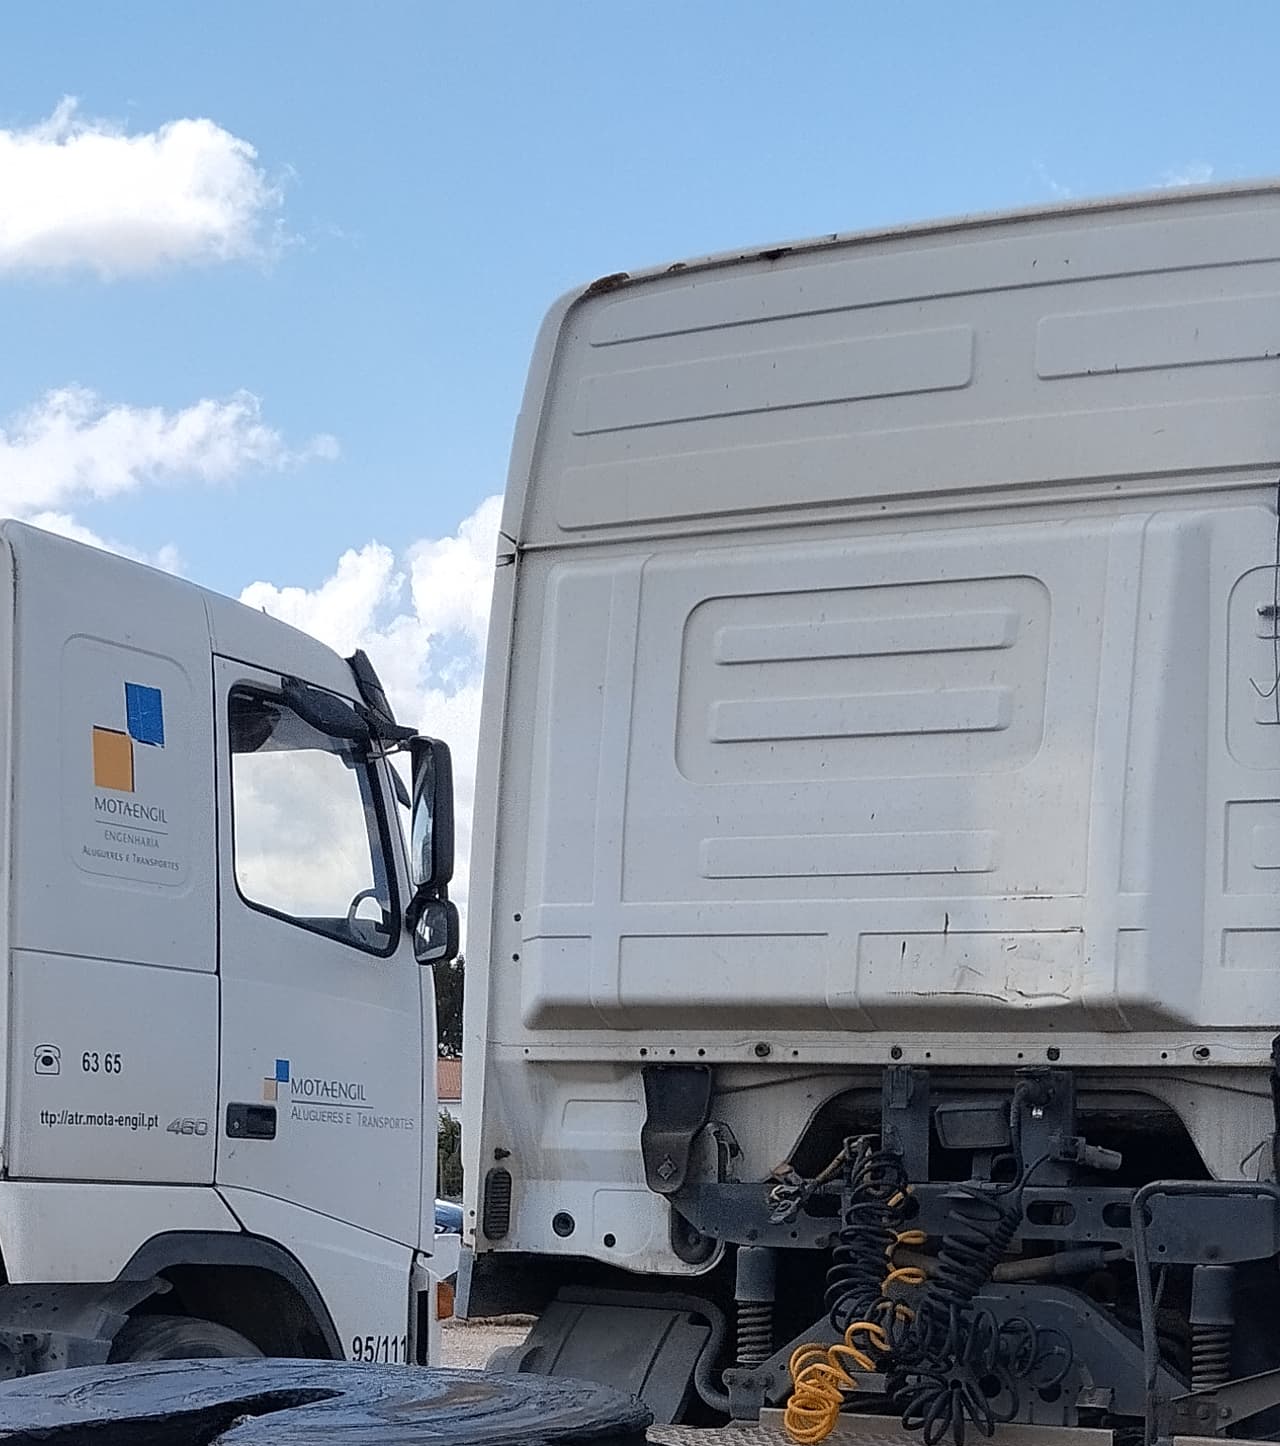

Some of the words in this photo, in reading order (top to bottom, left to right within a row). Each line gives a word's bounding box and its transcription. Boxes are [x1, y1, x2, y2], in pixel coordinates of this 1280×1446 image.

[104, 830, 160, 849] ENGENHARIA
[82, 1051, 100, 1073] 63
[104, 1052, 122, 1074] 65
[166, 1117, 209, 1136] 460
[352, 1334, 407, 1363] 95/111
